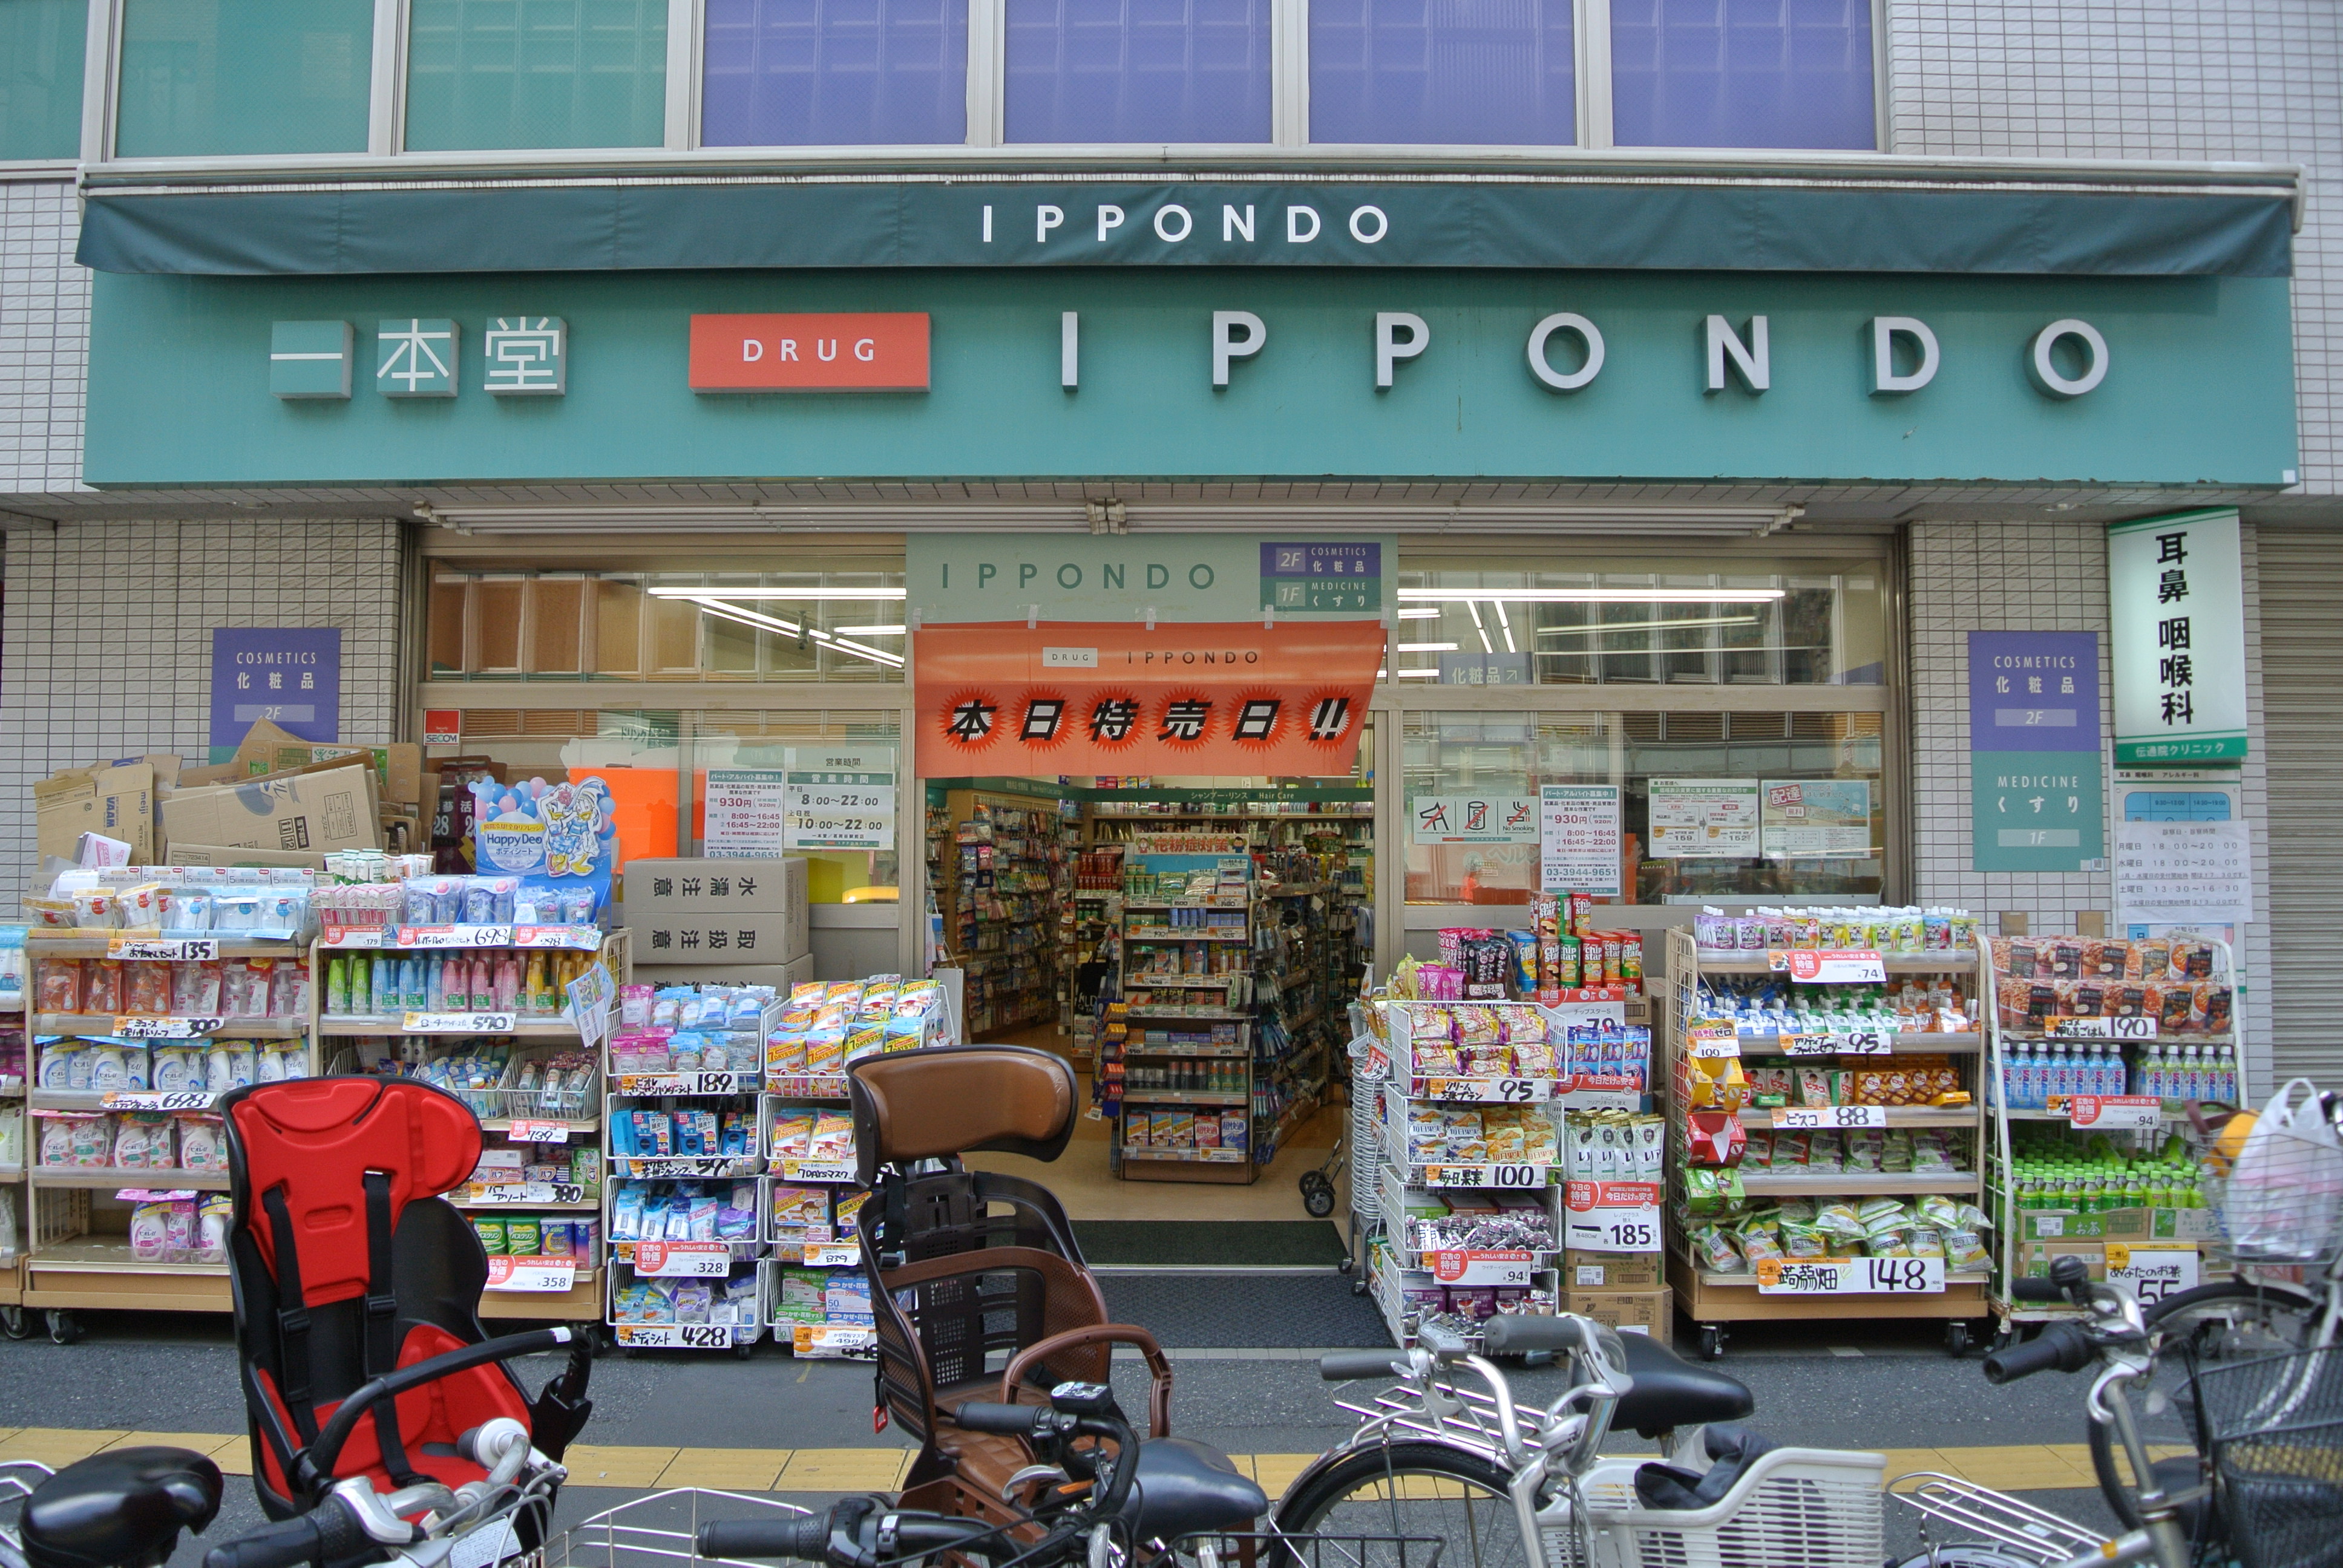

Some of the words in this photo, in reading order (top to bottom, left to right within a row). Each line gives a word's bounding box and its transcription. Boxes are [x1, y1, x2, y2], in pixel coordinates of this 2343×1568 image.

[983, 204, 1388, 243] IPPONDO
[270, 316, 560, 391] 一本堂
[742, 338, 876, 363] DRUG
[1062, 310, 2109, 396] IPPONDO
[1311, 547, 1366, 556] COSMETICS
[1280, 552, 1301, 567] 2F
[1312, 561, 1364, 572] 化粧品
[942, 563, 1216, 590] IPPONDO
[1311, 582, 1366, 590] MEDICINE
[1281, 587, 1300, 601] 1F
[1313, 595, 1365, 607] くすり
[2155, 531, 2194, 725] 耳鼻咽喉科
[237, 652, 316, 664] COSMETICS
[1052, 653, 1090, 662] DRUG
[1127, 651, 1259, 665] IPPONDO
[1994, 656, 2076, 668] COSMETICS
[237, 672, 314, 690] 化粧品
[1452, 667, 1501, 684] 化粧品
[1996, 676, 2075, 694] 化粧品
[264, 706, 282, 720] 2F
[2025, 711, 2043, 725] 2F
[426, 734, 457, 743] SECOM
[826, 758, 860, 768] 営業時間
[811, 774, 869, 784] 営業時間
[1997, 776, 2079, 788] MEDICINE
[1771, 786, 1801, 805] 配達
[139, 791, 148, 814] meiji
[460, 801, 472, 813] 活
[719, 797, 752, 808] 930円
[1999, 796, 2079, 813] くすり
[106, 796, 116, 828] VAAM
[1555, 814, 1587, 825] 930円
[487, 834, 520, 846] Happy
[522, 834, 542, 844] Deo
[2030, 831, 2046, 845] 1F
[1154, 838, 1229, 852] 花粉症対策
[188, 853, 209, 861] 723414
[1539, 901, 1556, 912] chip
[1539, 908, 1556, 918] star
[474, 927, 508, 945] 698
[652, 929, 756, 950] 取扱注意
[182, 941, 211, 959] 135
[1584, 946, 1602, 956] chip
[1623, 942, 1640, 953] chip
[1623, 949, 1640, 958] star
[1520, 952, 1536, 961] star
[1795, 960, 1815, 969] 特価
[1862, 969, 1879, 978] 74
[1540, 990, 1559, 999] 特価
[472, 1016, 507, 1029] 570
[2111, 1018, 2148, 1037] 190
[1849, 1033, 1879, 1052] 95
[1701, 1048, 1720, 1057] 100
[635, 1077, 658, 1086] ビオレ
[697, 1073, 732, 1093] 189
[1769, 1078, 1789, 1091] ビスコ
[1890, 1077, 1904, 1087] ビスコ
[1940, 1074, 1953, 1083] ビスコ
[1446, 1082, 1471, 1091] クリーム
[1499, 1080, 1534, 1102] 95
[1804, 1081, 1826, 1094] ビスコ
[163, 1093, 208, 1108] 698
[2076, 1105, 2095, 1114] 特価
[1786, 1114, 1818, 1126] ビスコ
[1835, 1106, 1869, 1126] 88
[2138, 1116, 2154, 1126] 94
[1196, 1125, 1218, 1135] 超快適
[1222, 1120, 1245, 1130] 超快適
[529, 1130, 552, 1142] 739
[1439, 1168, 1483, 1186] 毎日果実
[1495, 1165, 1535, 1186] 100
[551, 1184, 581, 1202] 380
[1571, 1191, 1590, 1201] 特価
[1606, 1192, 1654, 1201] 今日だけの安さ
[1610, 1224, 1651, 1245] 185
[641, 1251, 661, 1261] 特価
[2108, 1250, 2128, 1258] 一推し
[698, 1263, 723, 1273] 328
[1440, 1260, 1460, 1270] 特価
[1507, 1271, 1524, 1281] 94
[1869, 1258, 1927, 1291] 148
[2109, 1265, 2181, 1278] あなたのお茶
[542, 1277, 566, 1287] 358
[1778, 1265, 1838, 1291] 蒟蒻畑
[681, 1326, 726, 1347] 428
